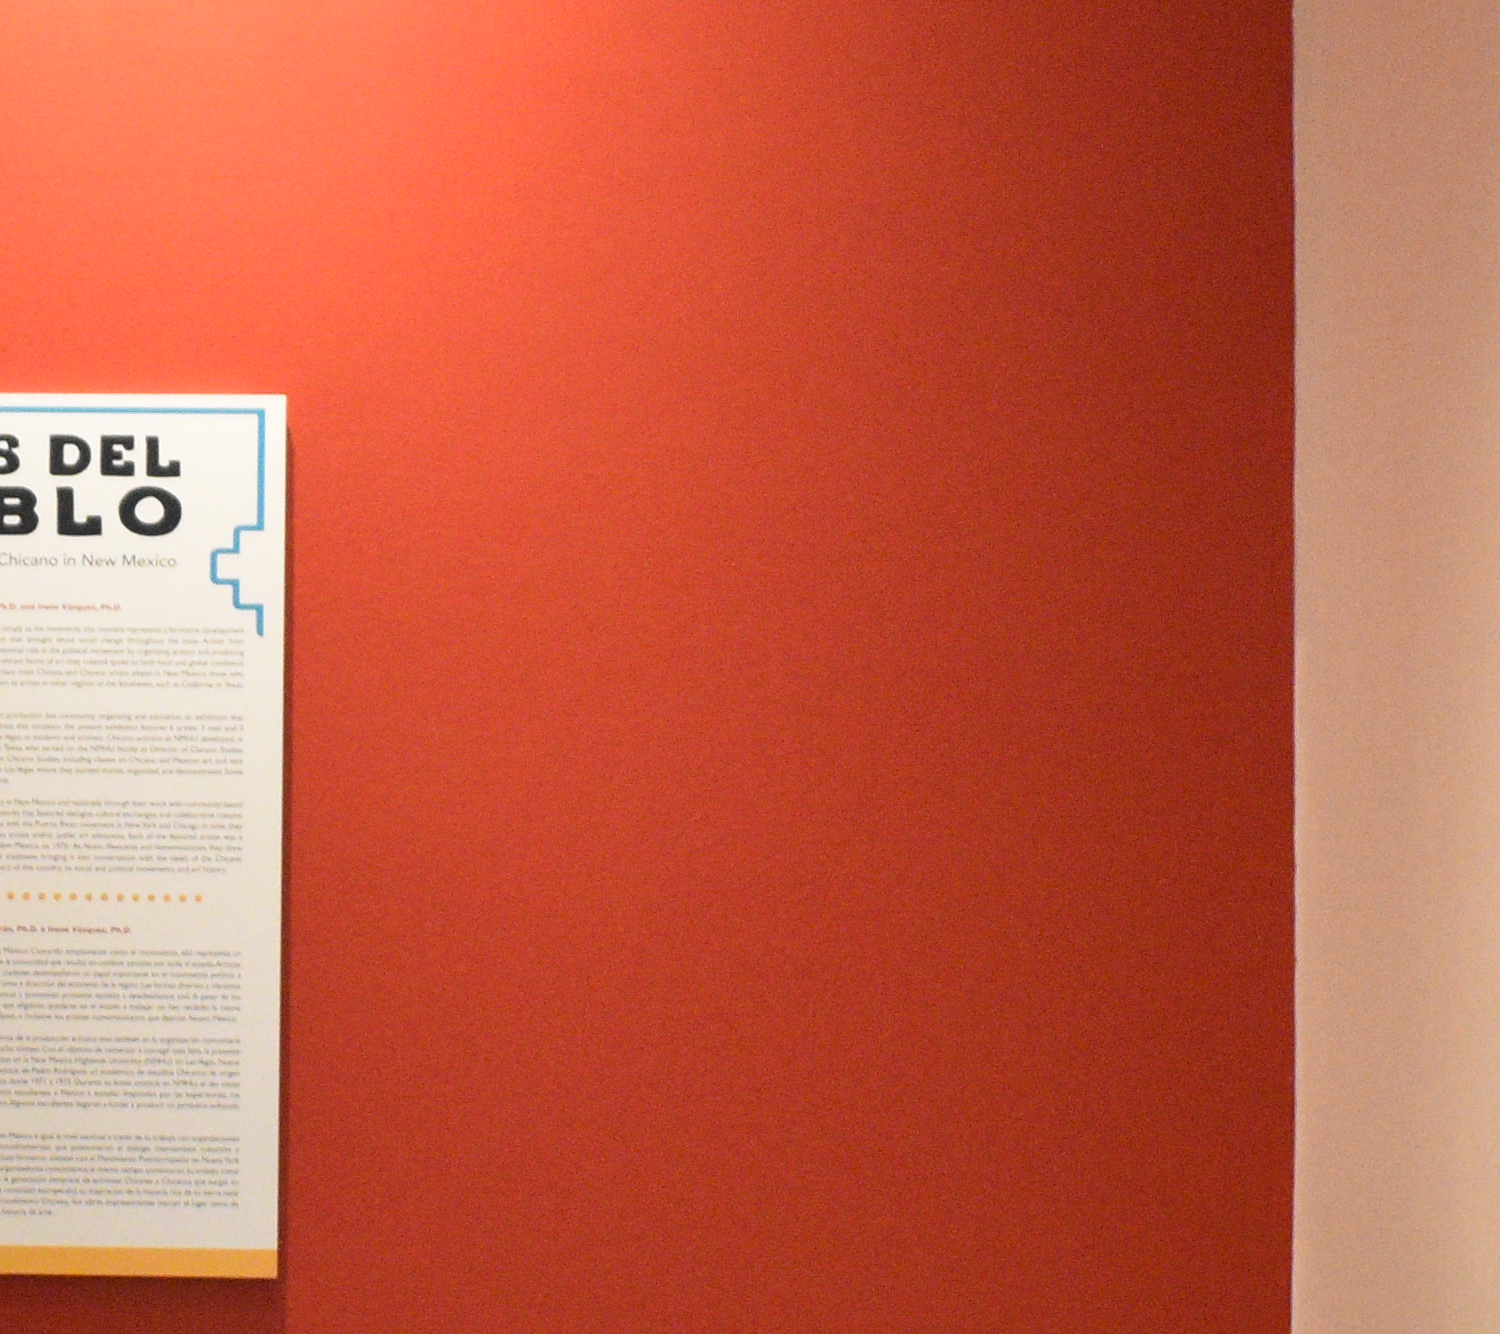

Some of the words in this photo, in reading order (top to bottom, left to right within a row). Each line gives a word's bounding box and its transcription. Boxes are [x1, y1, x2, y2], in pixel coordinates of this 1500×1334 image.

[47, 433, 182, 478] DEL
[63, 553, 76, 567] in
[82, 553, 117, 567] New
[122, 553, 177, 568] Mexico
